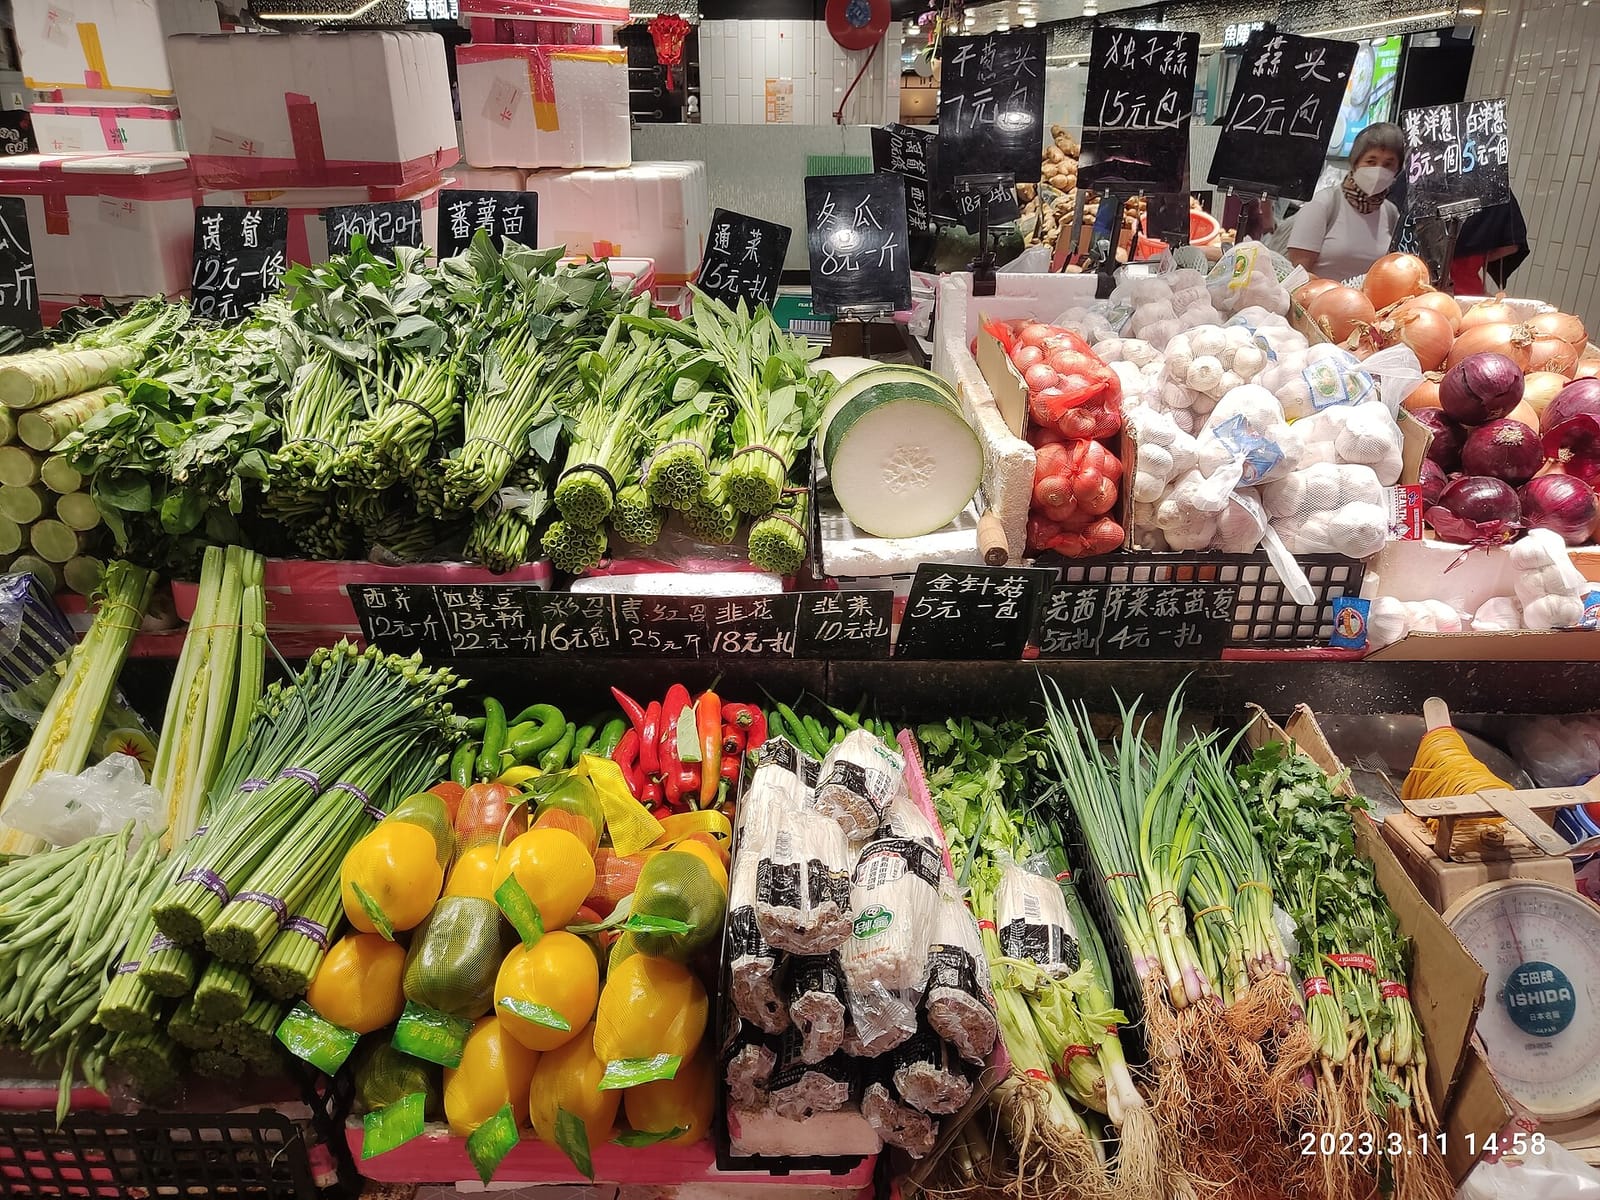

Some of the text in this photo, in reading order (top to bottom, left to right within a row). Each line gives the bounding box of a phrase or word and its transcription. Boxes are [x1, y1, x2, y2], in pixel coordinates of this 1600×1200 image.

[1104, 32, 1187, 78] 独子蒜
[1099, 88, 1181, 130] 15元包
[1225, 92, 1322, 140] 12元包
[816, 191, 883, 231] 冬瓜
[334, 207, 421, 247] 枸杞叶
[713, 223, 762, 263] 通菜
[820, 232, 899, 275] 8元一斤
[698, 258, 769, 302] 15元一扎
[444, 588, 522, 611] 四季豆
[811, 595, 873, 618] 韭菜
[910, 596, 1018, 619] 5元一包
[1044, 588, 1099, 624] 芫茜
[368, 615, 438, 641] 12元一斤
[452, 610, 526, 632] 13元半斤
[629, 628, 701, 658] 25元斤
[712, 628, 793, 653] 18元一扎
[1040, 628, 1095, 652] 5元扎
[1108, 622, 1202, 650] 4元一扎
[1518, 970, 1555, 986] 石田牌
[1509, 988, 1571, 1007] ISHIDA
